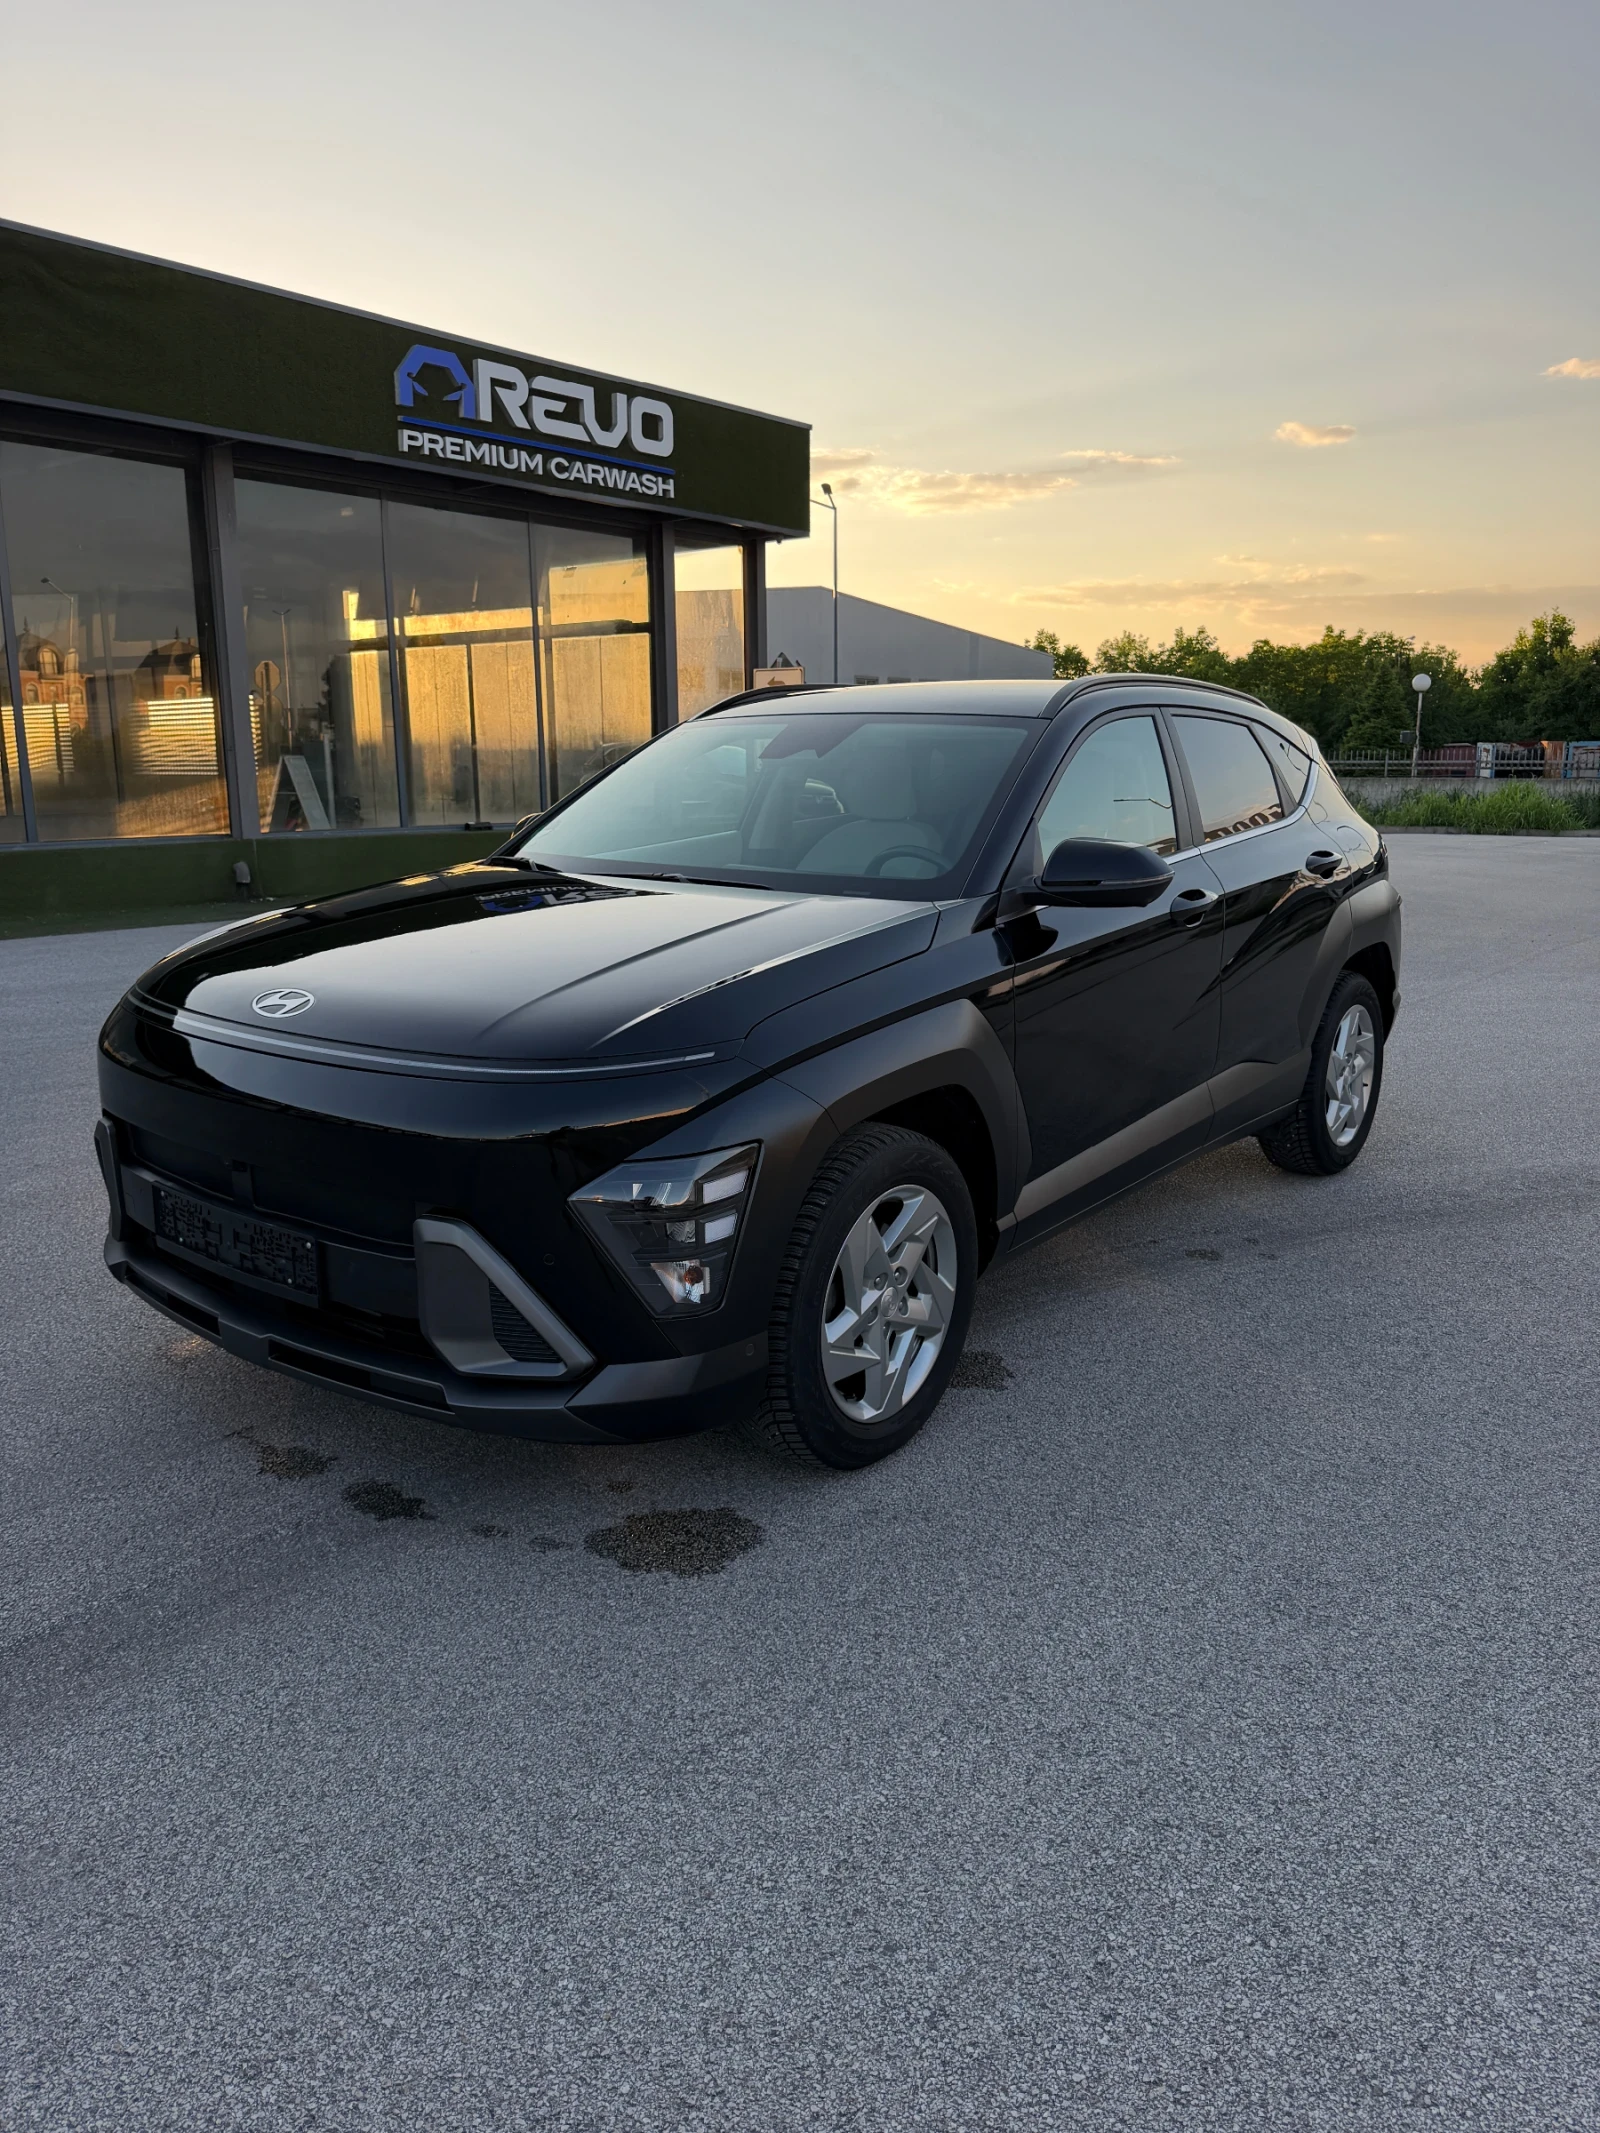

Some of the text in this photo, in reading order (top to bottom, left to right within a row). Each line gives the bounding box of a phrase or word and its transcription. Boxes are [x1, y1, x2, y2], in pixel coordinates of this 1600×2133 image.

[394, 344, 674, 457] AREVO
[398, 429, 675, 498] PREMIUM CARWASH
